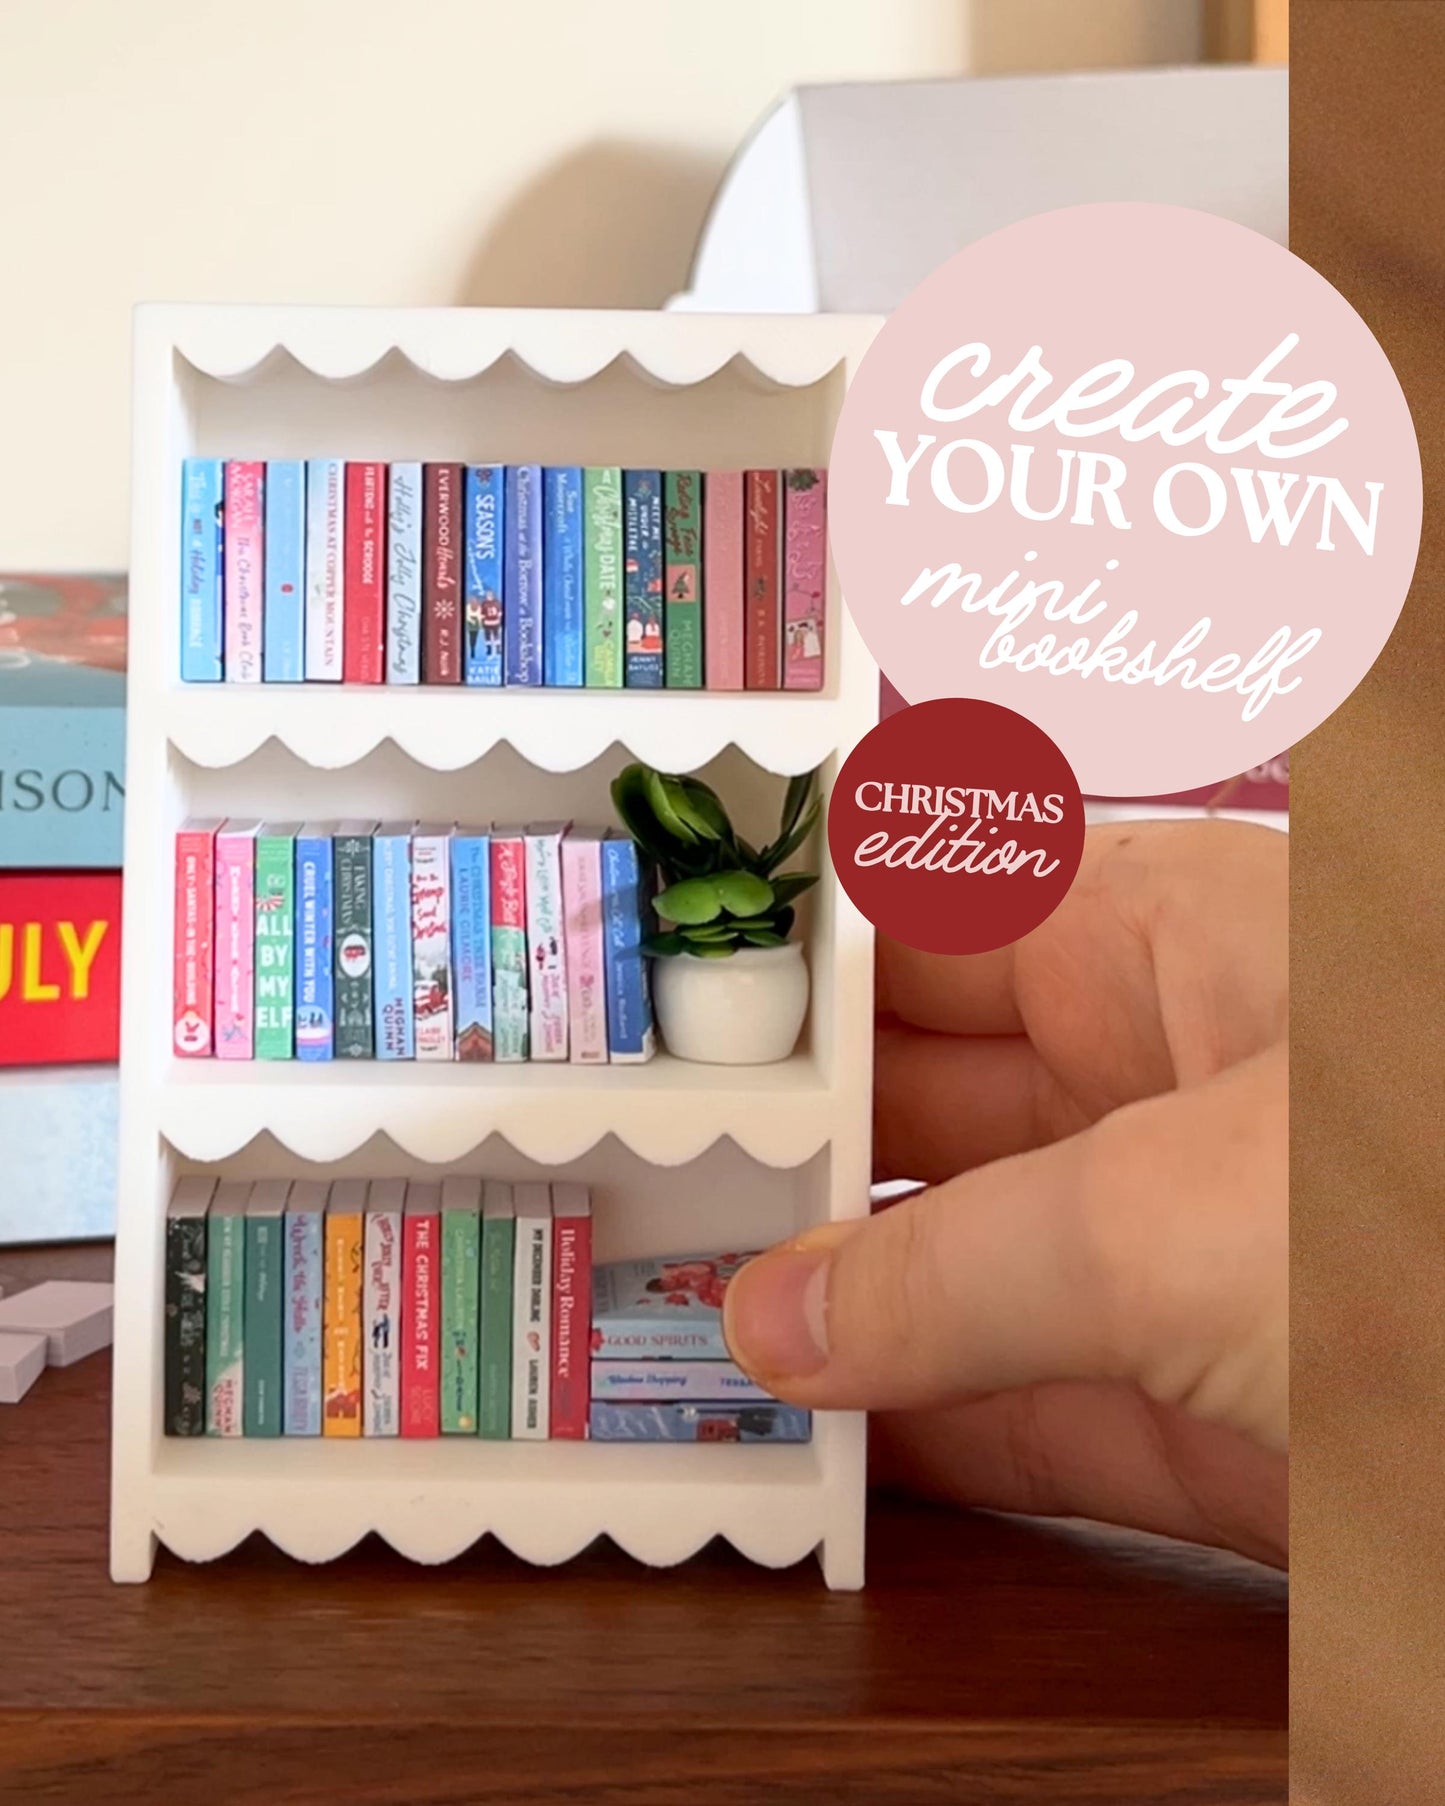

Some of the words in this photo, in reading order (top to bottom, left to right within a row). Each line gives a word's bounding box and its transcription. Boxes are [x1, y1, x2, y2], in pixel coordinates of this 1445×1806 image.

[327, 463, 339, 534] CHRISTMAS
[437, 469, 450, 546] EVERWOOD
[517, 466, 531, 530] Christmas
[326, 537, 338, 550] AT
[475, 493, 496, 559] SEASON'S
[389, 542, 417, 586] Jolly
[518, 560, 534, 605] Borrow
[599, 554, 616, 591] DATE
[323, 602, 336, 667] MOUNTAIN
[391, 592, 417, 674] Christmas
[514, 617, 533, 683] Bookshop
[671, 629, 682, 677] QUINN
[682, 621, 693, 685] MEGHAN
[303, 862, 316, 899] CRUEL
[256, 915, 292, 936] ALL
[303, 901, 316, 945] WINTER
[261, 945, 288, 967] BY
[260, 975, 289, 998] MY
[382, 1005, 395, 1051] QUINN
[394, 998, 406, 1056] MEGHAN
[415, 1220, 429, 1248] THE
[556, 1228, 576, 1294] Holiday
[415, 1254, 429, 1340] CHRISTMAS
[415, 1344, 428, 1370] FIX
[558, 1295, 575, 1377] Romance
[607, 1334, 648, 1346] GOOD
[652, 1334, 708, 1346] SPIRITS
